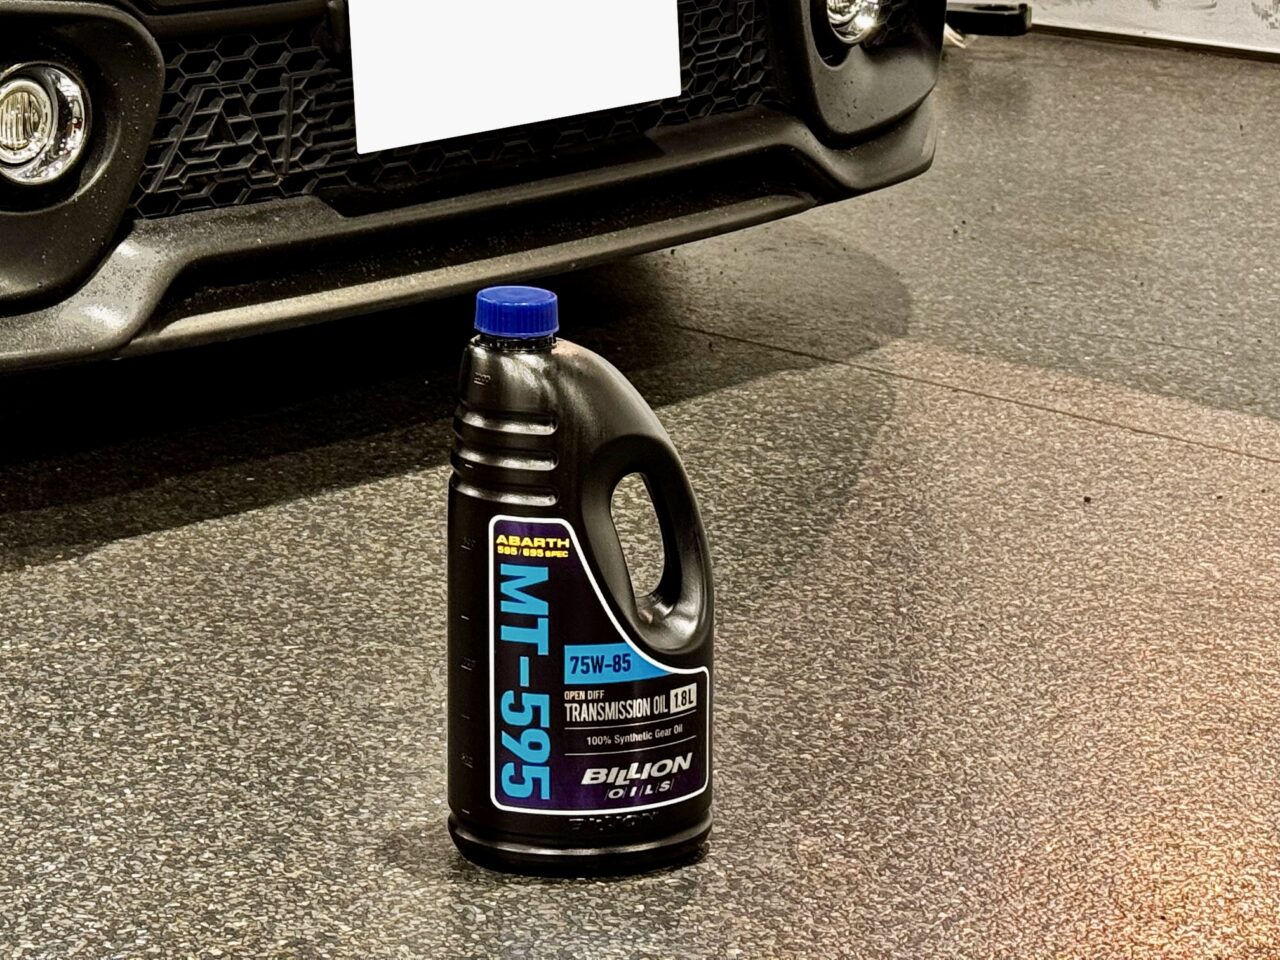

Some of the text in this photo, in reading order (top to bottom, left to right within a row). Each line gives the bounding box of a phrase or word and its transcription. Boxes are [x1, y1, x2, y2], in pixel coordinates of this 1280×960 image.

[496, 534, 570, 548] ABARTH
[544, 550, 569, 558] SPEC
[569, 653, 632, 675] 75W-85
[500, 563, 551, 800] MT-595
[564, 689, 605, 700] OPEN DIFF
[564, 688, 694, 722] TRANSMISSION OIL 1.8L
[586, 723, 683, 746] 100% Synthetic Gear Oil
[580, 751, 694, 786] BILLION
